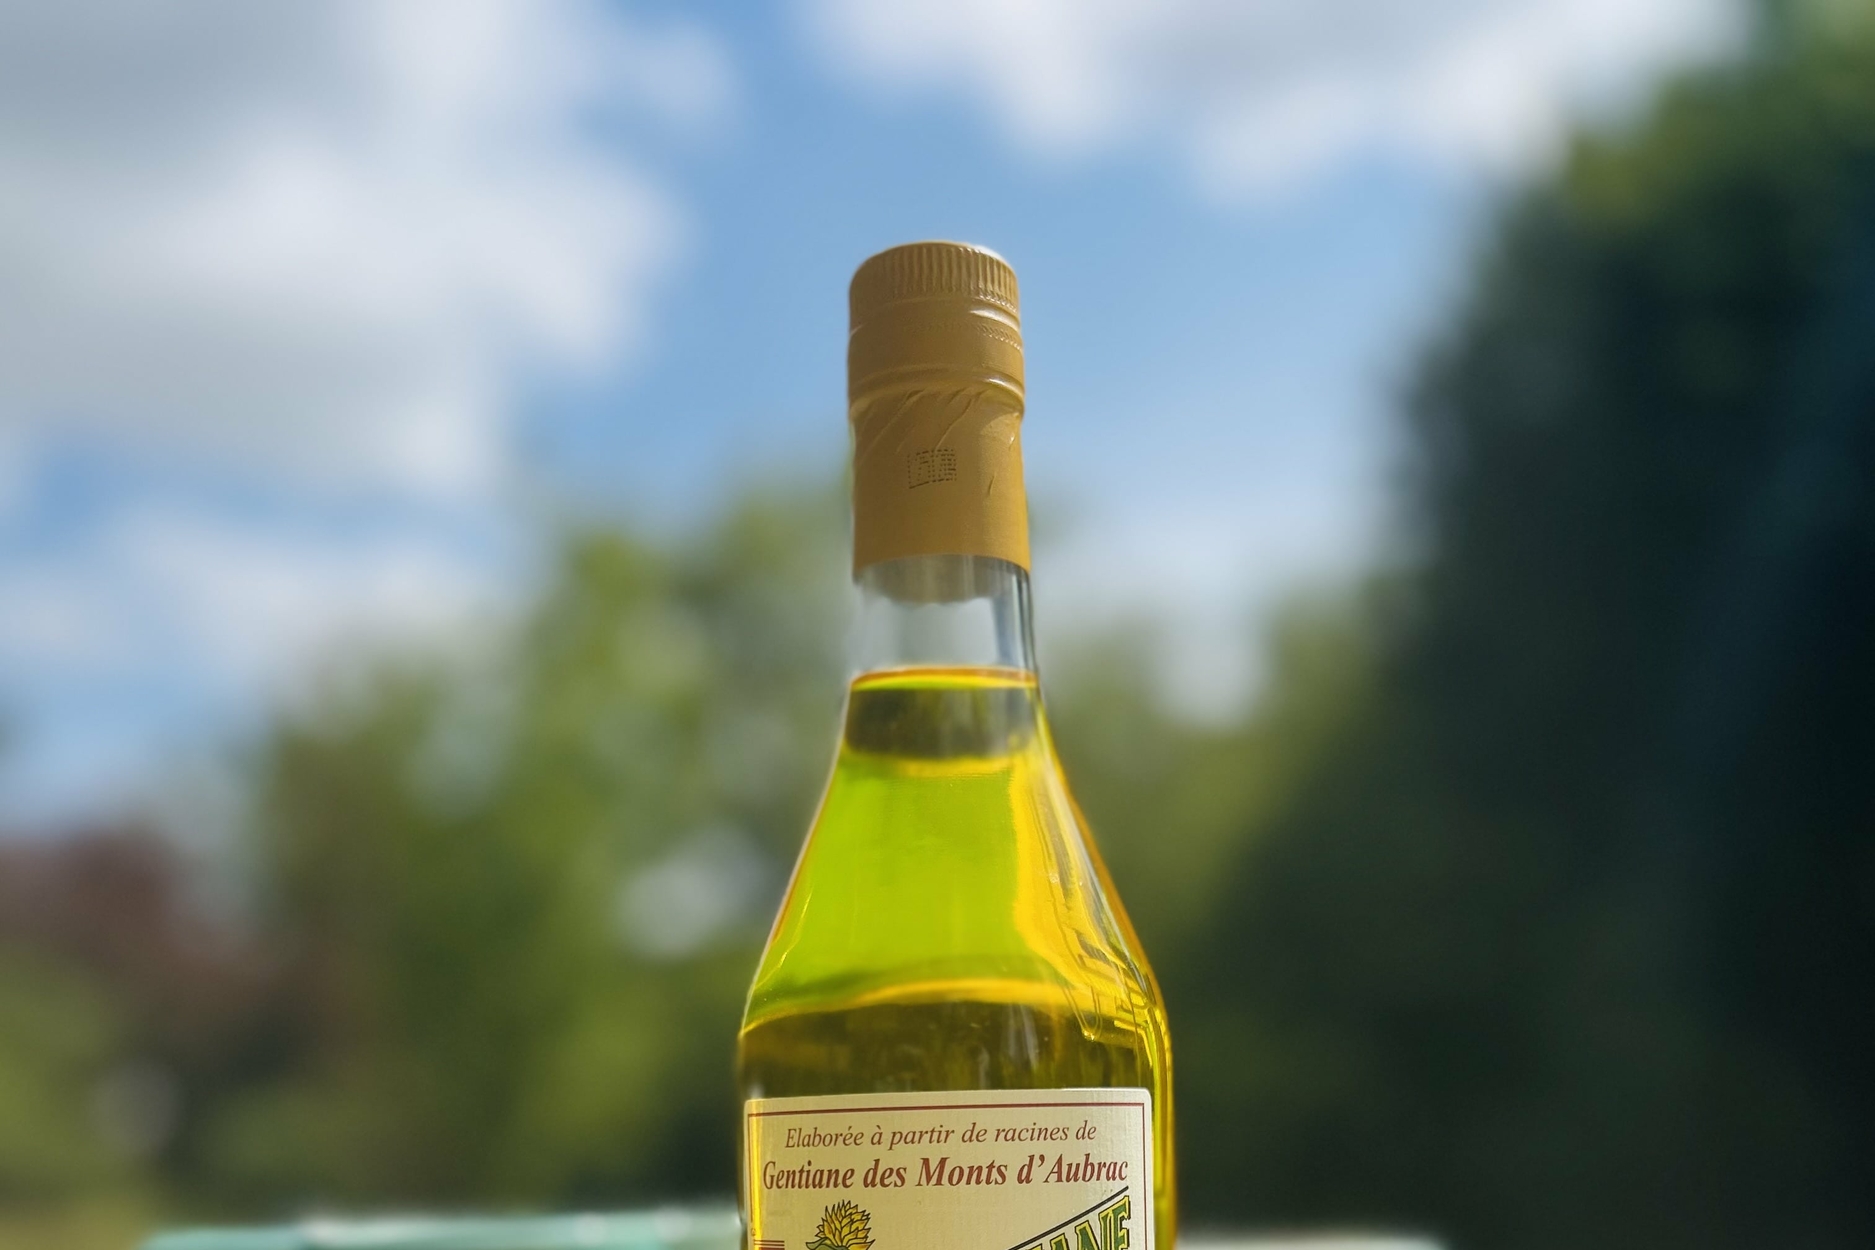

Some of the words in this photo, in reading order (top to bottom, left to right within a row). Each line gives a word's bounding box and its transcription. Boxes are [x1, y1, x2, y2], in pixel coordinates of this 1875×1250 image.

[785, 1125, 864, 1149] Elaborée
[870, 1124, 883, 1146] à
[888, 1125, 955, 1150] partir
[961, 1122, 988, 1144] de
[994, 1123, 1069, 1143] racines
[1075, 1120, 1097, 1141] de
[763, 1159, 855, 1191] Gentiane
[863, 1158, 907, 1188] des
[915, 1156, 1008, 1187] Monts
[1016, 1153, 1128, 1184] d’Aubrac
